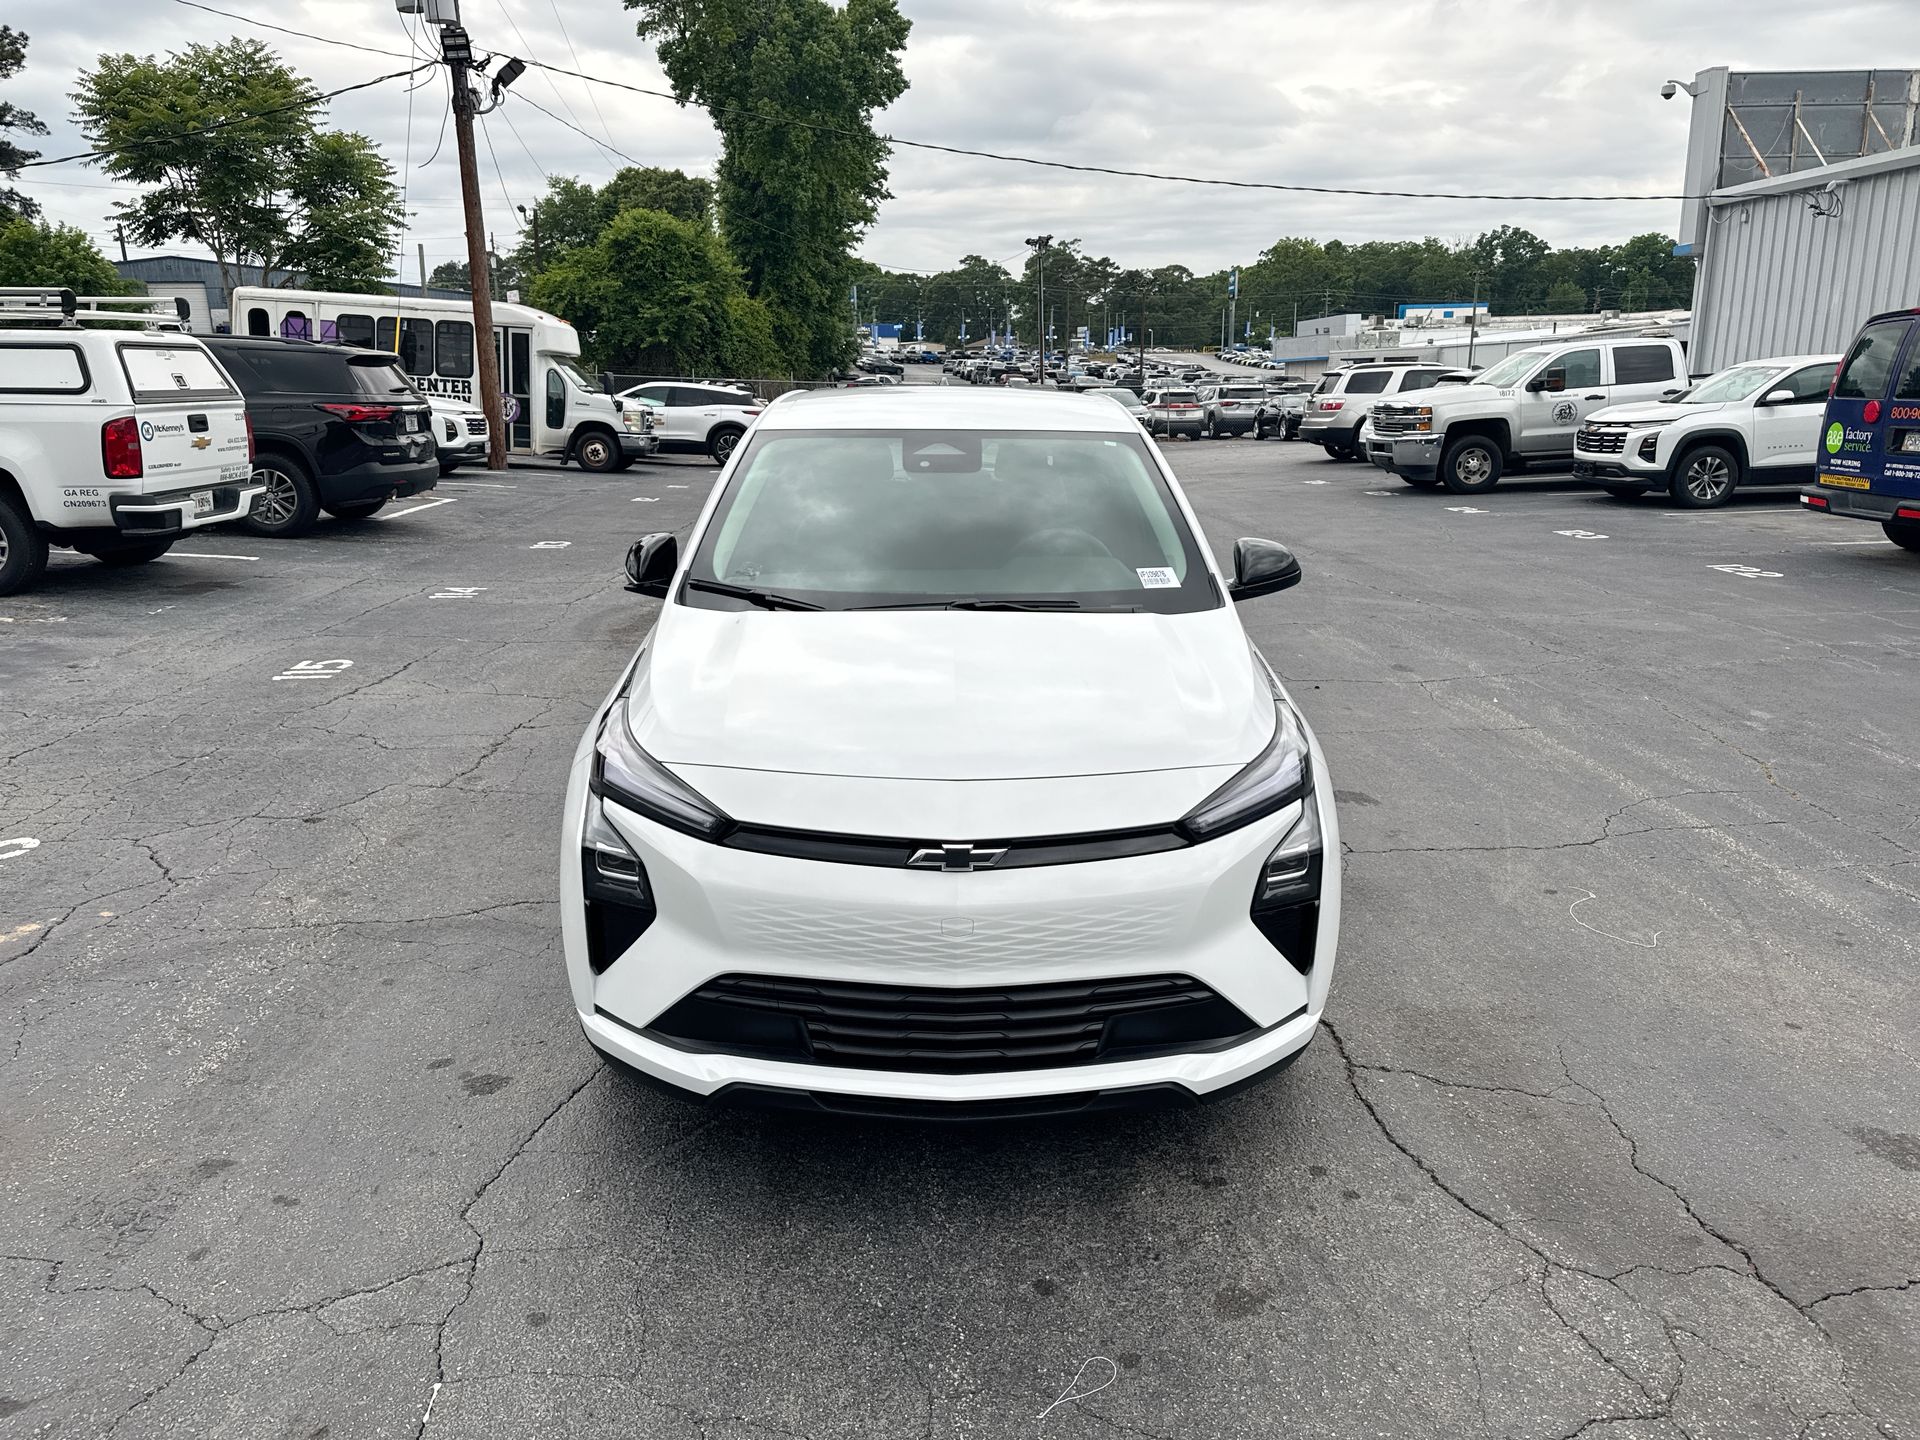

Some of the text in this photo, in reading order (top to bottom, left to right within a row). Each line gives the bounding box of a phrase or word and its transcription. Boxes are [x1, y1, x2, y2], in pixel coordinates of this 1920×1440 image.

[154, 424, 184, 432] McKenney's
[1845, 427, 1872, 443] factory
[1842, 459, 1861, 468] HIRING
[63, 489, 77, 497] GA
[63, 500, 107, 508] CN209673
[1705, 563, 1784, 578] 122
[428, 587, 488, 599] 114
[272, 659, 354, 681] 115
